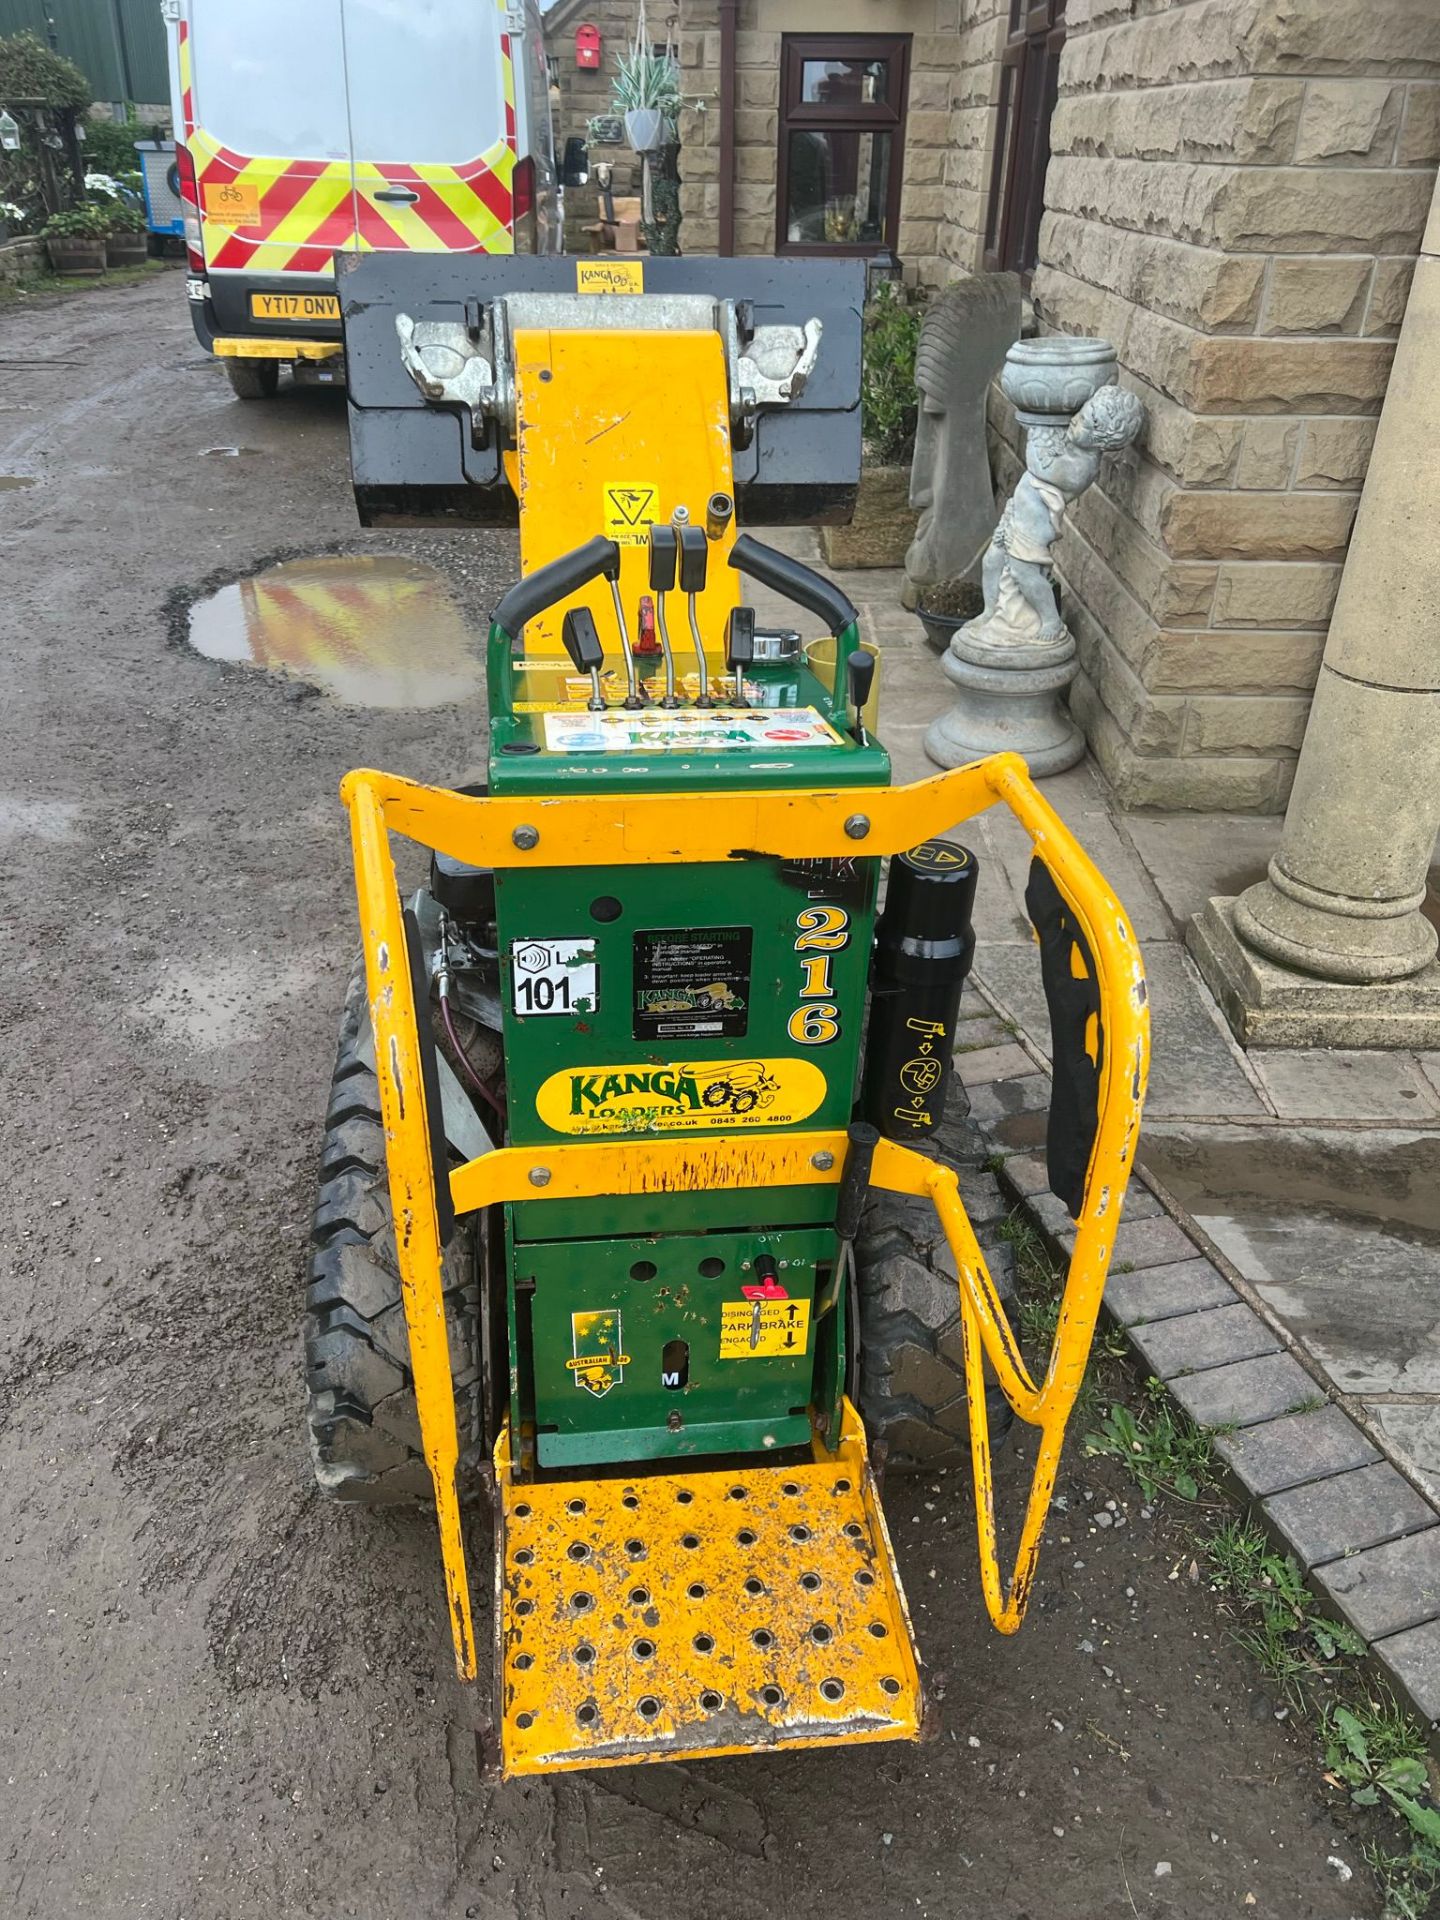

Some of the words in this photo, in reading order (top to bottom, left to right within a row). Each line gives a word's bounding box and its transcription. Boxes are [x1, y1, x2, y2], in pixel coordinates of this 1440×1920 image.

[262, 297, 298, 314] YT17
[304, 298, 335, 314] ONV
[647, 933, 689, 943] BEFORE
[691, 931, 741, 942] STARTING
[517, 976, 569, 1010] 101
[637, 987, 698, 1010] KANGA
[569, 1071, 702, 1115] KANGA
[589, 1104, 686, 1119] LOADERS
[710, 1117, 736, 1126] 0845
[742, 1116, 761, 1124] 260
[767, 1114, 792, 1123] 4800
[722, 1309, 779, 1317] DISINGGED
[721, 1322, 753, 1331] PARK
[759, 1320, 804, 1330] BRAKE
[720, 1336, 766, 1344] ENGAGD
[569, 1357, 608, 1367] AUSTRALIAN
